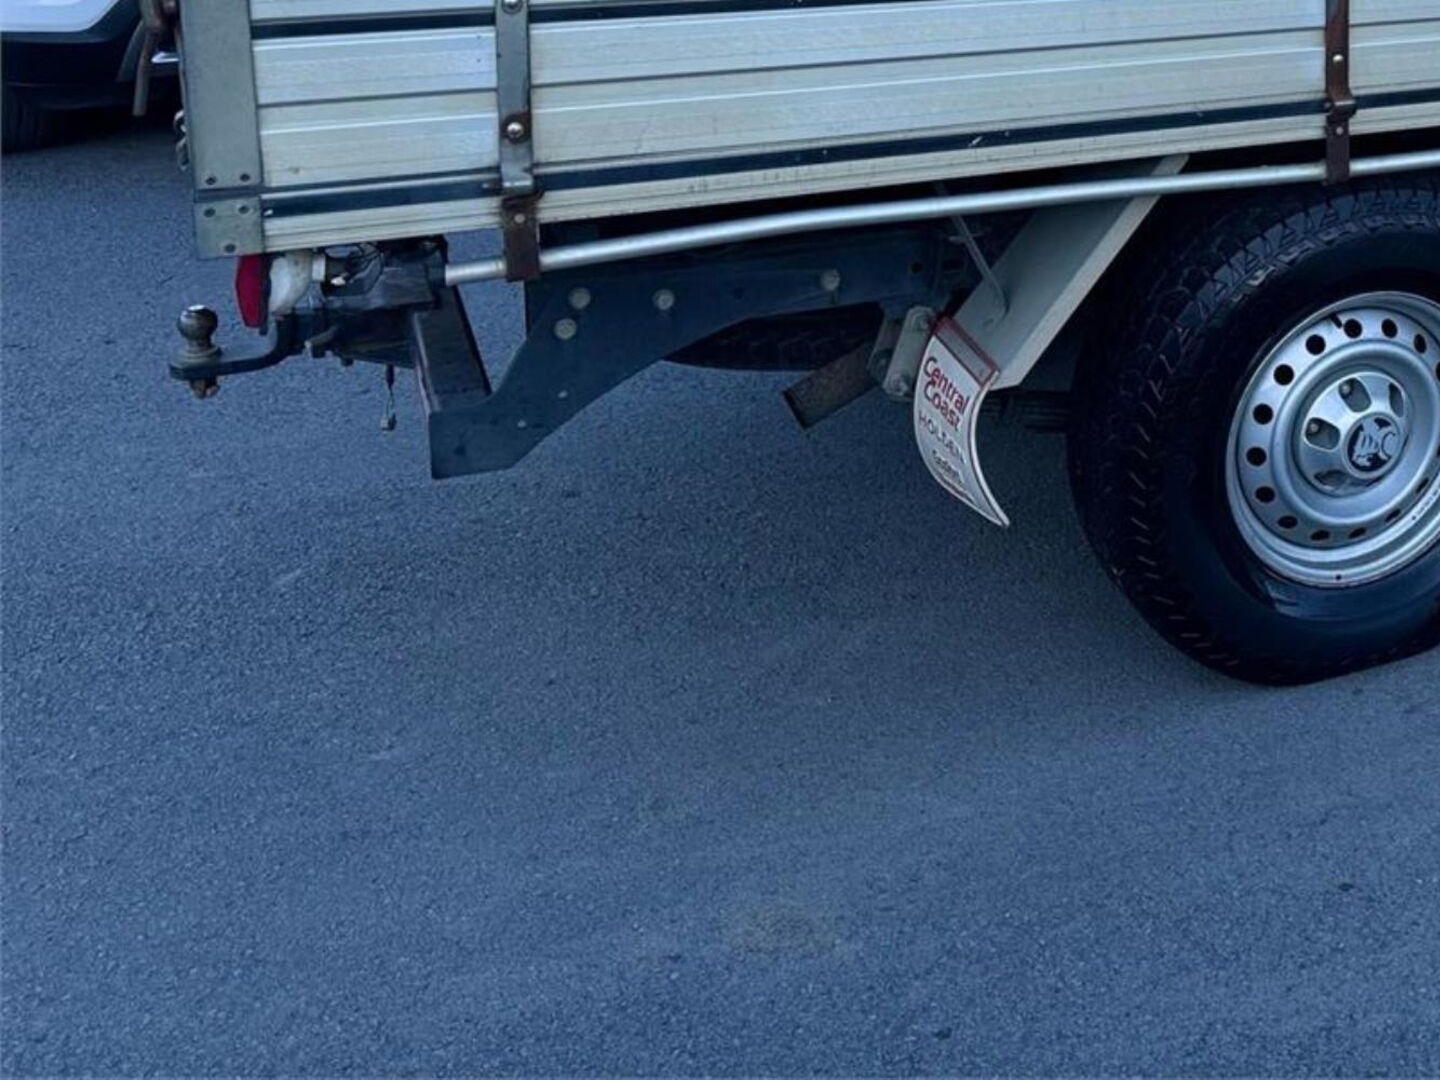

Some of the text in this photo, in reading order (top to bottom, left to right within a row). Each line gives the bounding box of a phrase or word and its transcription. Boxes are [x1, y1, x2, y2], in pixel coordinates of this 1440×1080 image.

[923, 357, 971, 416] Central
[923, 381, 962, 432] Coast
[918, 409, 967, 464] HOLDEN
